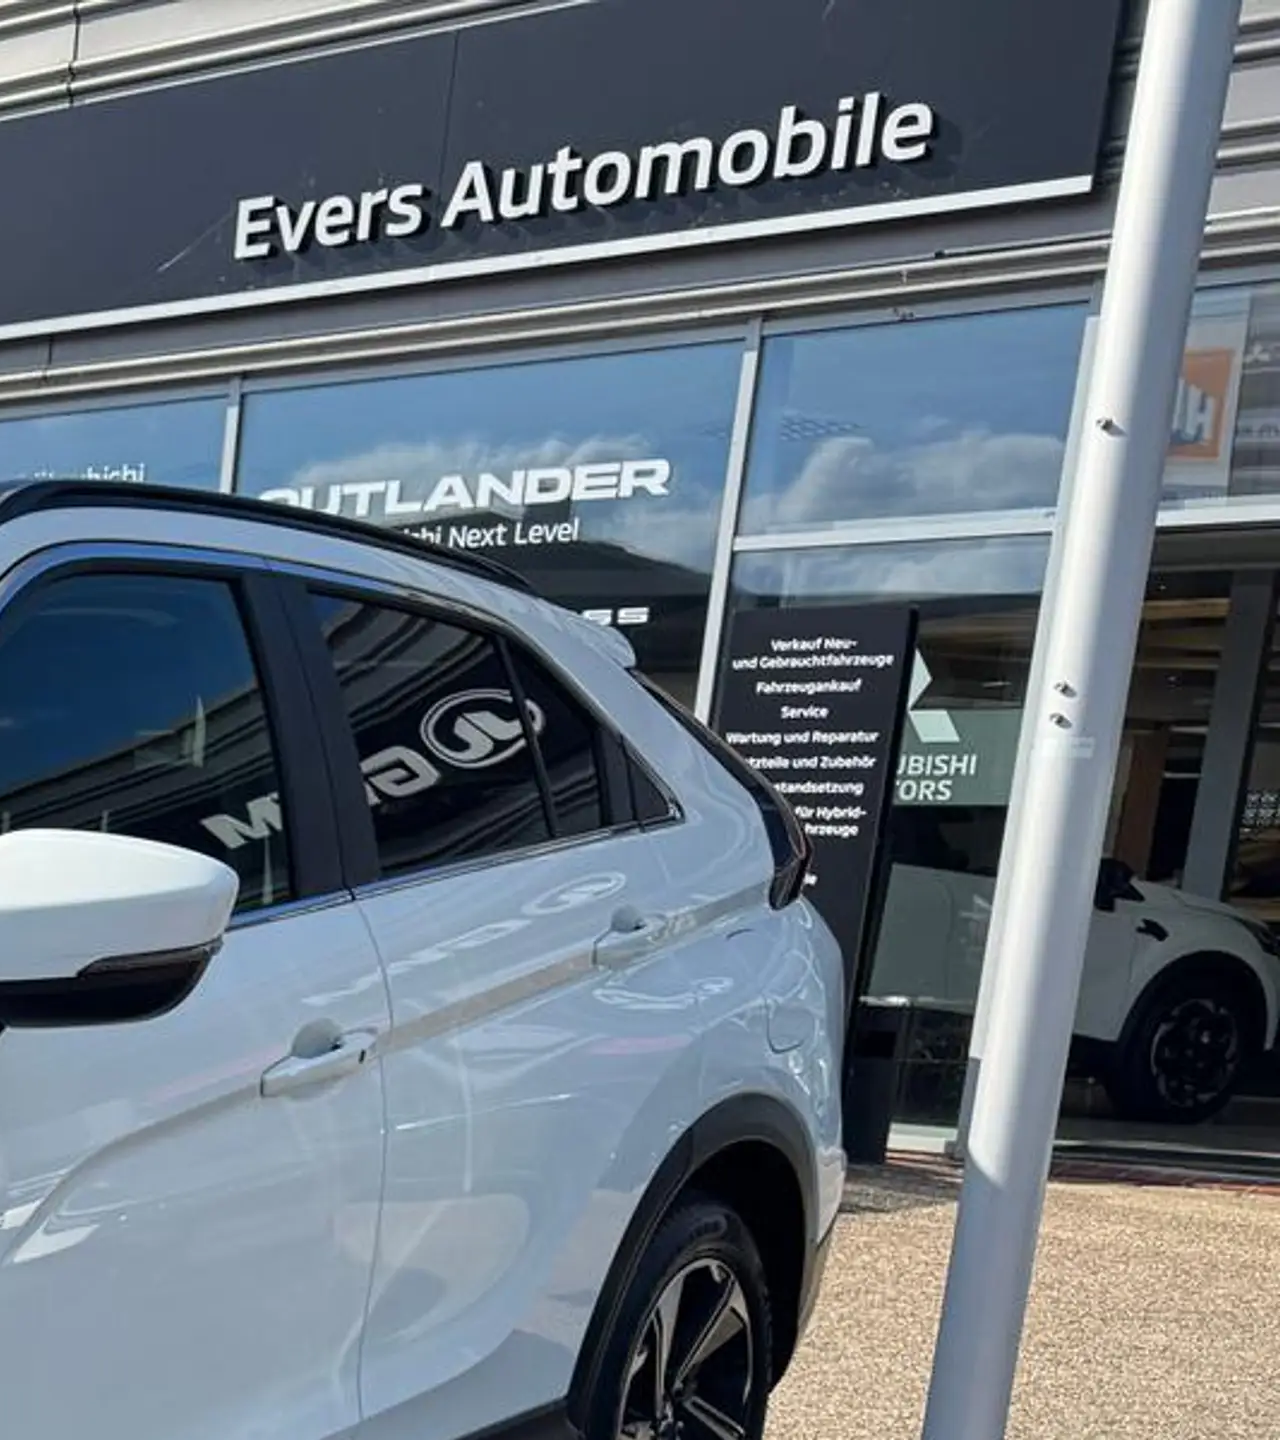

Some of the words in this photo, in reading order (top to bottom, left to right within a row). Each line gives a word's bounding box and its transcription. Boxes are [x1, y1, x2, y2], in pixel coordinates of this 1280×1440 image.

[233, 181, 423, 260] Evers
[440, 91, 934, 228] Automobile
[448, 523, 507, 550] Next
[514, 517, 580, 545] Level
[771, 638, 824, 651] Verkauf
[824, 637, 859, 650] Neu-
[732, 658, 759, 671] und
[759, 654, 895, 670] Gebrauchtfahrzeuge
[755, 678, 863, 696] Fahrzeugankauf
[780, 705, 830, 719] Service
[725, 732, 782, 746] Wartung
[783, 731, 811, 744] und
[811, 730, 880, 745] Reparatur
[792, 756, 819, 768] und
[819, 755, 878, 769] Zubehör
[896, 753, 978, 776] BISHI
[895, 779, 953, 801] ORS
[816, 806, 868, 820] Hybrid-
